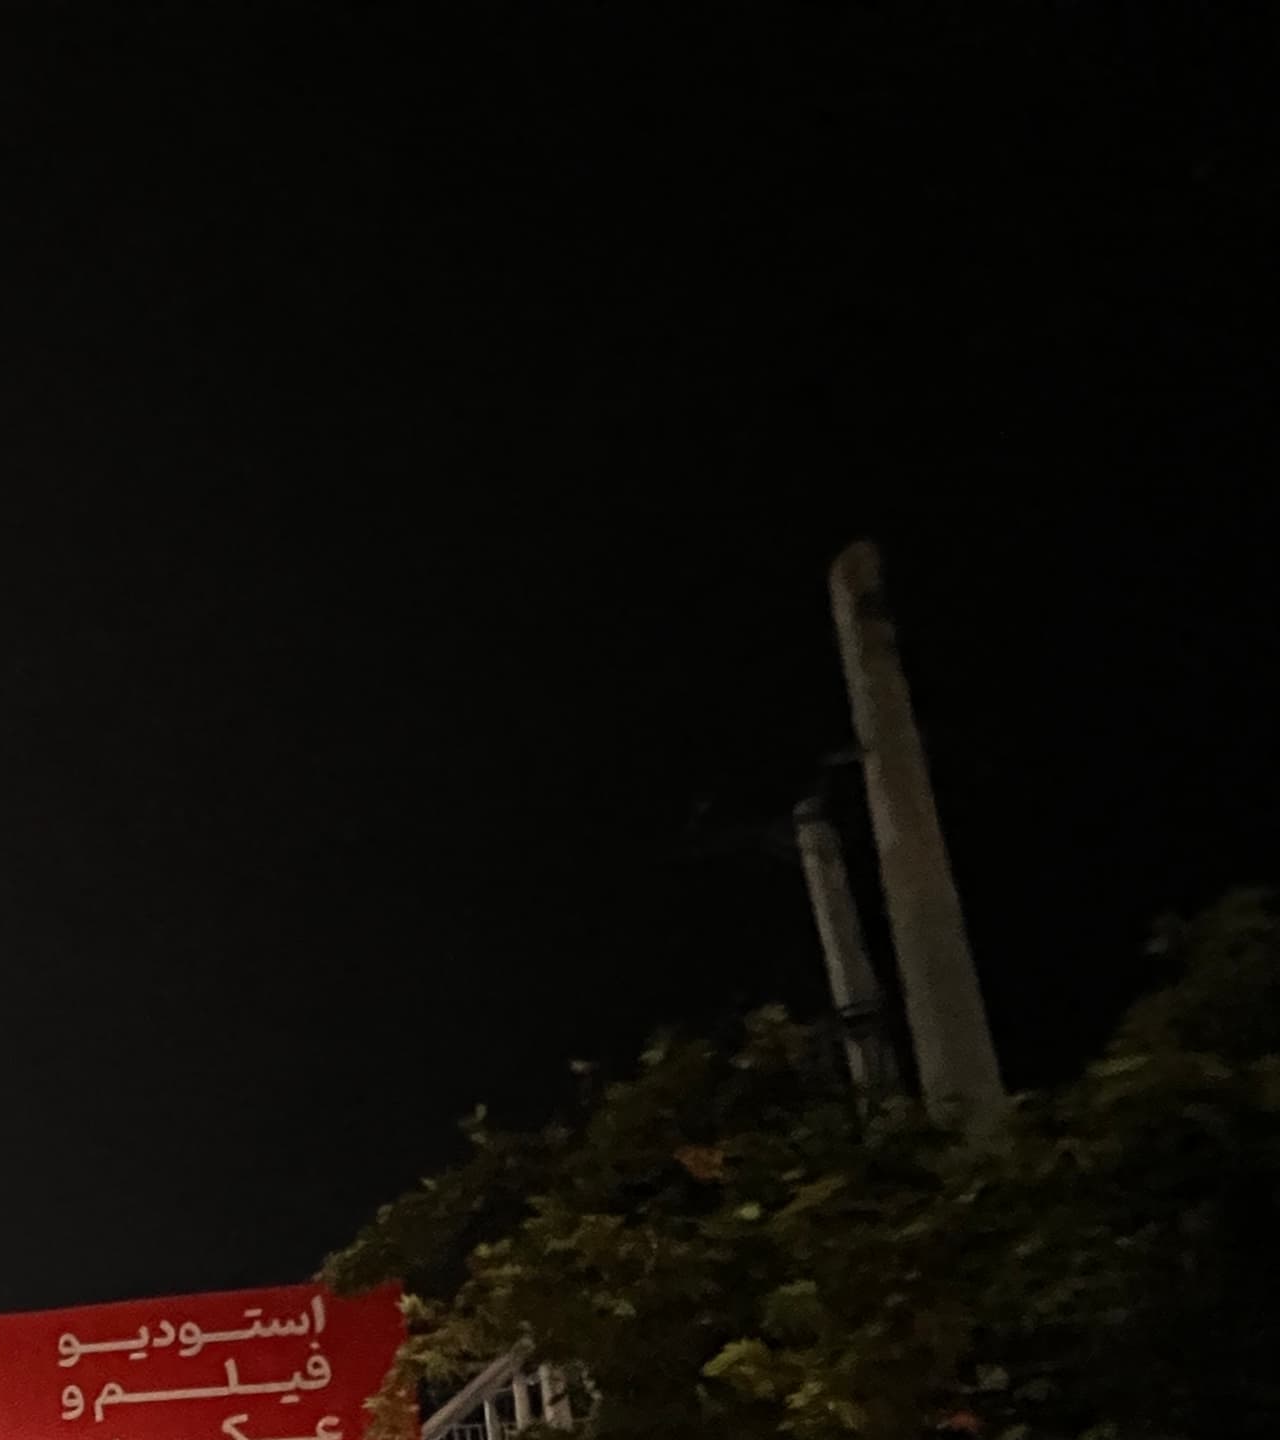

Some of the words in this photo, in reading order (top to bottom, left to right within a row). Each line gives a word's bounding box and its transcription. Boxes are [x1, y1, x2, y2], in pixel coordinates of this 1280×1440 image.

[57, 1295, 327, 1367] استودیو
[61, 1382, 84, 1421] و
[94, 1342, 334, 1422] فیلم
